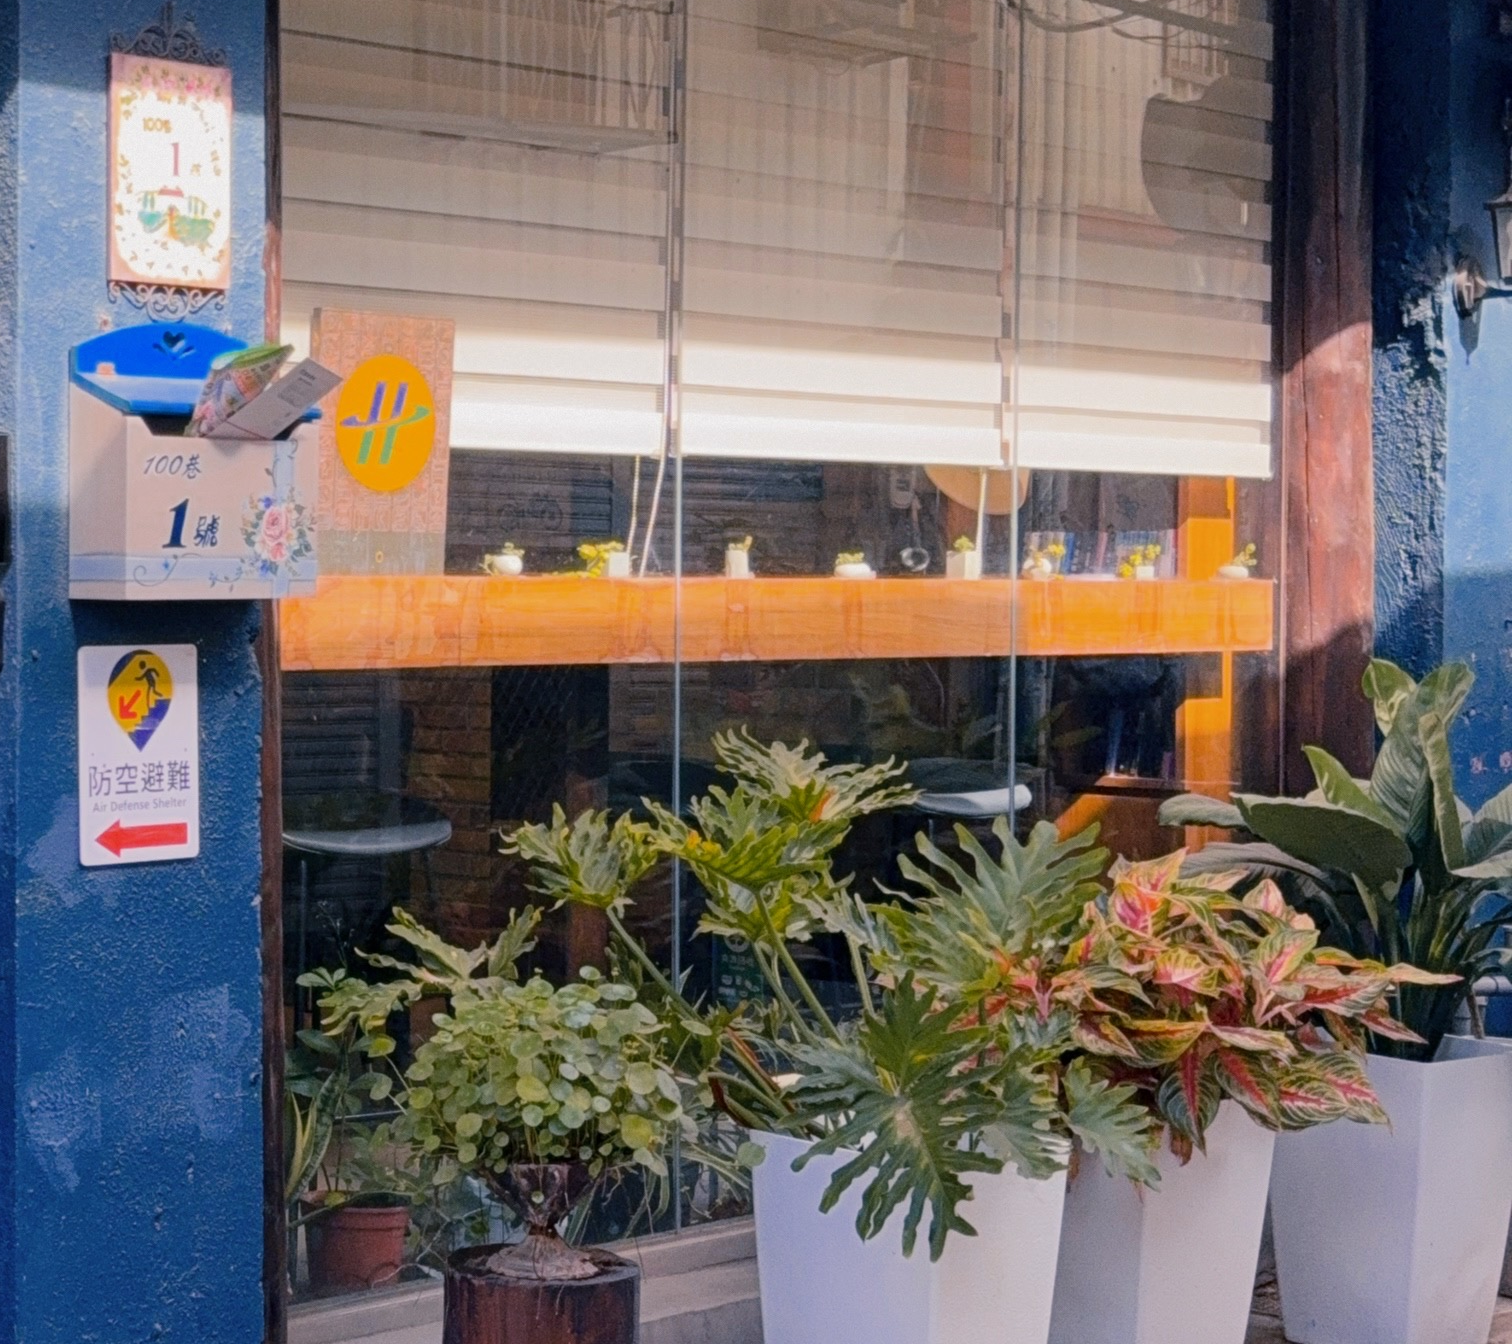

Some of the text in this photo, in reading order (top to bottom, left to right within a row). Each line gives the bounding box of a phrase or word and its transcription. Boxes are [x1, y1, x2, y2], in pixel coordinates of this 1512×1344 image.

[143, 454, 202, 480] 100巷
[89, 760, 191, 798] 防空避難
[93, 797, 187, 813] Air Defense Shelter
